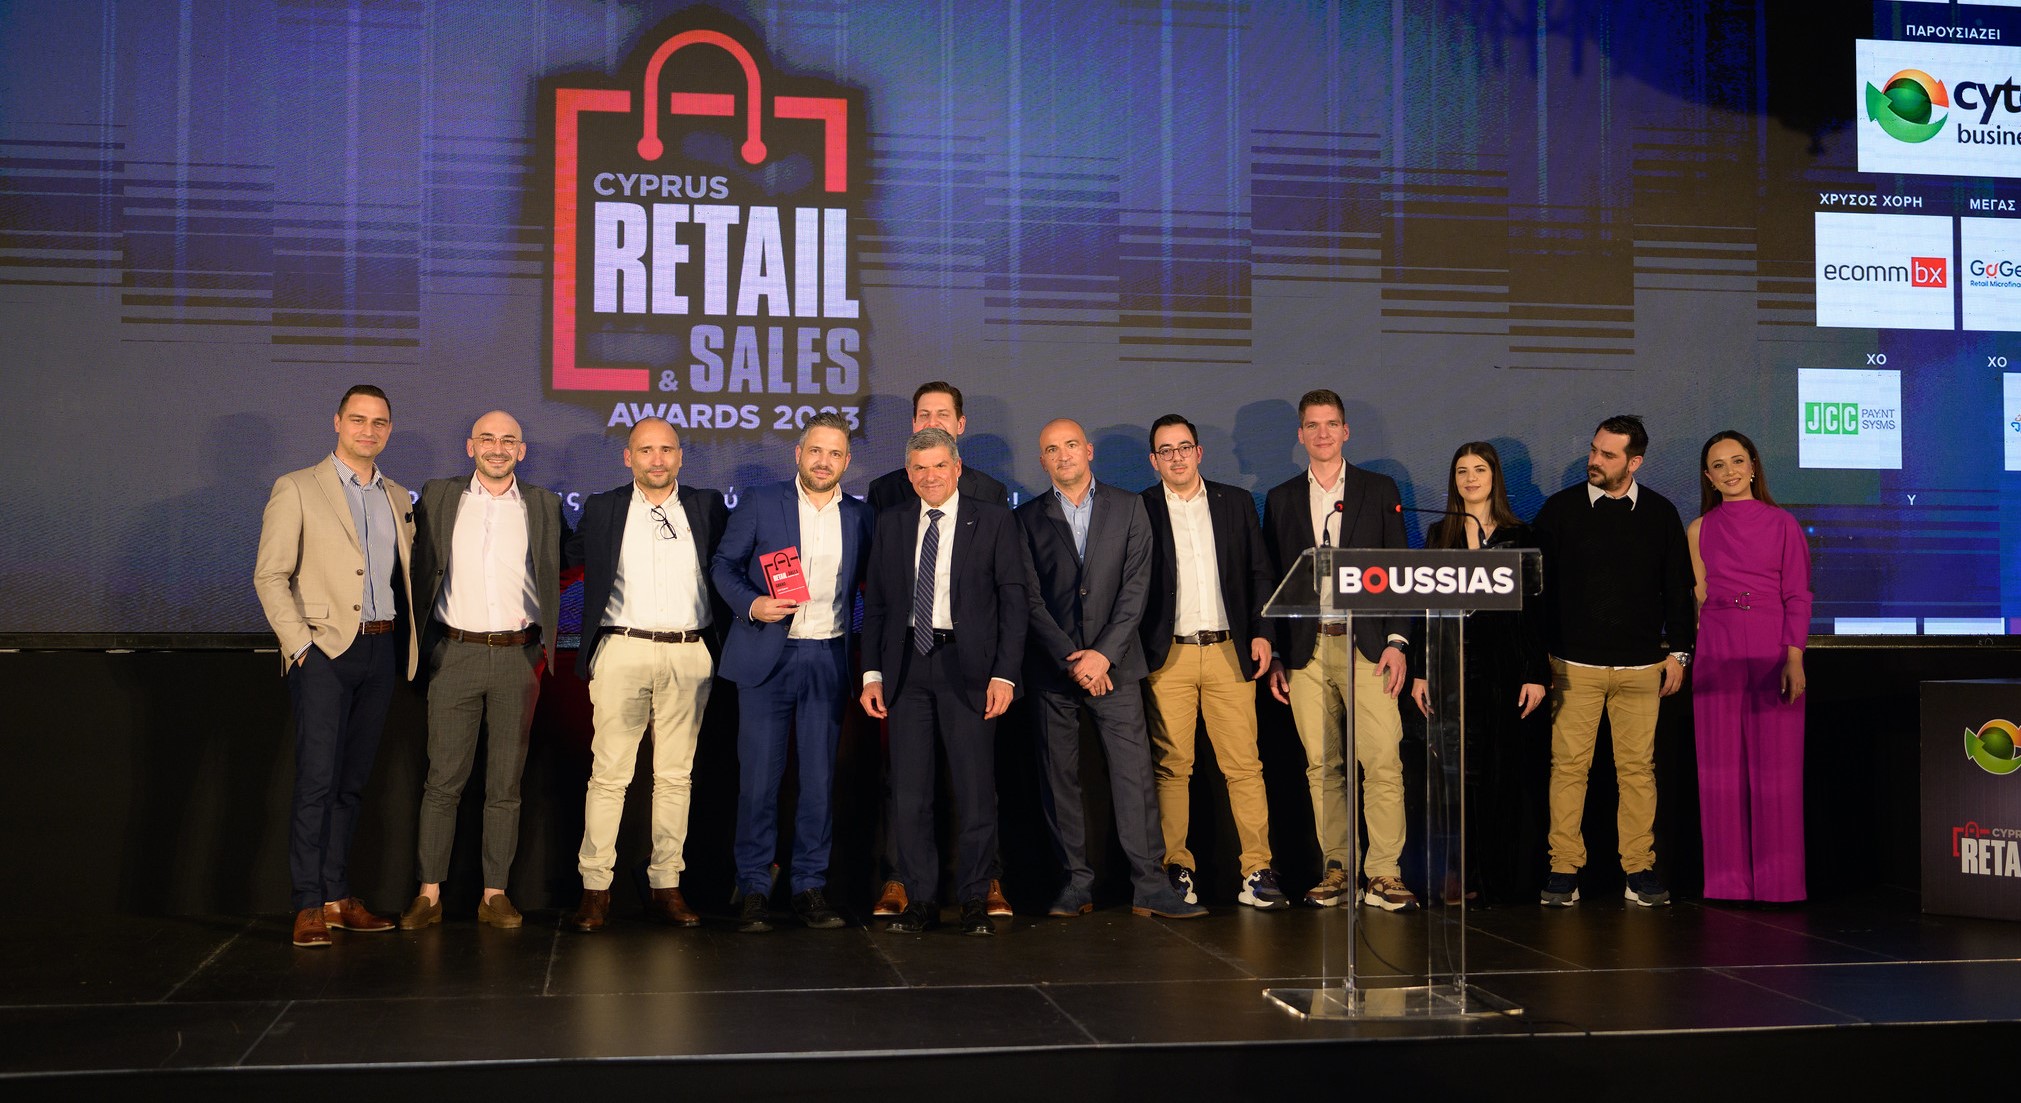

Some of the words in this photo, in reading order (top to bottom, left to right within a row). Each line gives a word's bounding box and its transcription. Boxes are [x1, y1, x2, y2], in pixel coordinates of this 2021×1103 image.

[1906, 24, 2001, 40] ΠΑΡΟΥΣΙΑΖΕΙ
[1953, 75, 2021, 125] cyt
[593, 172, 729, 200] CYPRUS
[1819, 192, 1878, 207] ΧΡΥΣΟΣ
[1882, 195, 1923, 208] ΧΟΡΗ
[1969, 198, 2016, 212] ΜΕΓΑΣ
[593, 201, 860, 319] RETAIL
[1970, 280, 1989, 288] Retail
[689, 324, 860, 395] SALES
[658, 369, 679, 392] &
[1807, 404, 1857, 432] JCC
[1338, 566, 1515, 594] BOUSSIAS
[1961, 837, 2021, 878] RETA
